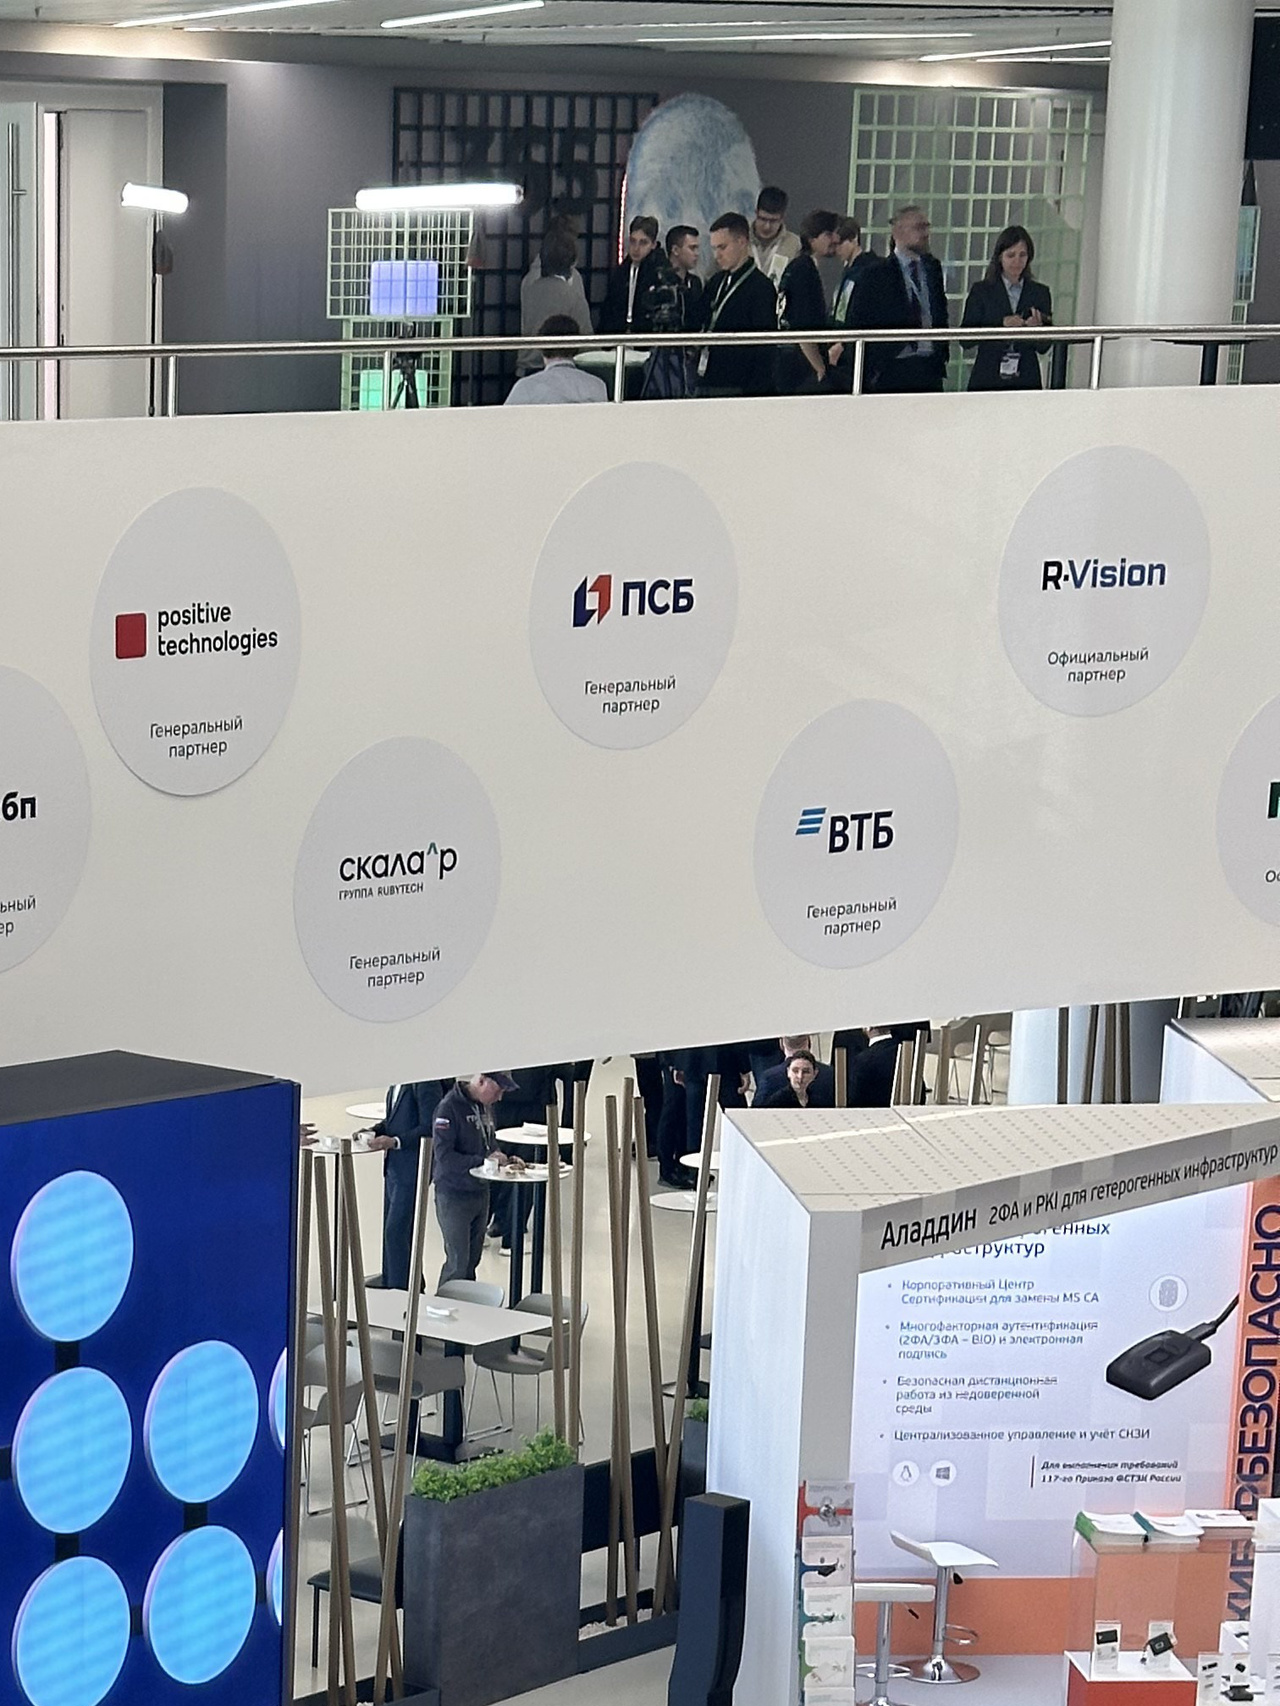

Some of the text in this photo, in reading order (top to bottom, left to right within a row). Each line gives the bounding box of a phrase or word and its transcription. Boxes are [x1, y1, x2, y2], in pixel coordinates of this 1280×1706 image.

[621, 578, 694, 617] ПСБ
[158, 601, 232, 630] positive
[158, 628, 278, 657] technologies
[1047, 647, 1149, 668] Официальный
[1067, 667, 1126, 685] партнер
[584, 675, 676, 697] Генеральный
[602, 699, 660, 716] партнер
[150, 715, 243, 740] Генеральный
[169, 738, 228, 760] партнер
[828, 810, 894, 854] ВТБ
[338, 882, 424, 901] ГРУППА RUBYTECH
[807, 897, 897, 921] Генеральный
[824, 918, 881, 937] партнер
[349, 949, 441, 972] Генеральный
[367, 971, 425, 988] партнер
[881, 1143, 1278, 1250] Аладдин 2ФА и PKI для гетерогенных инфраструктур
[902, 1278, 1035, 1292] Корпоративный Центр
[989, 1294, 1012, 1306] для
[900, 1321, 999, 1334] Многофакторная
[1009, 1336, 1084, 1346] электронная
[897, 1376, 1058, 1388] Безопасная дистанционная
[896, 1390, 936, 1402] работа
[955, 1390, 1040, 1402] недоверенной
[895, 1405, 933, 1416] среды
[893, 1429, 1005, 1442] Централизованное
[1006, 1430, 1076, 1442] управление
